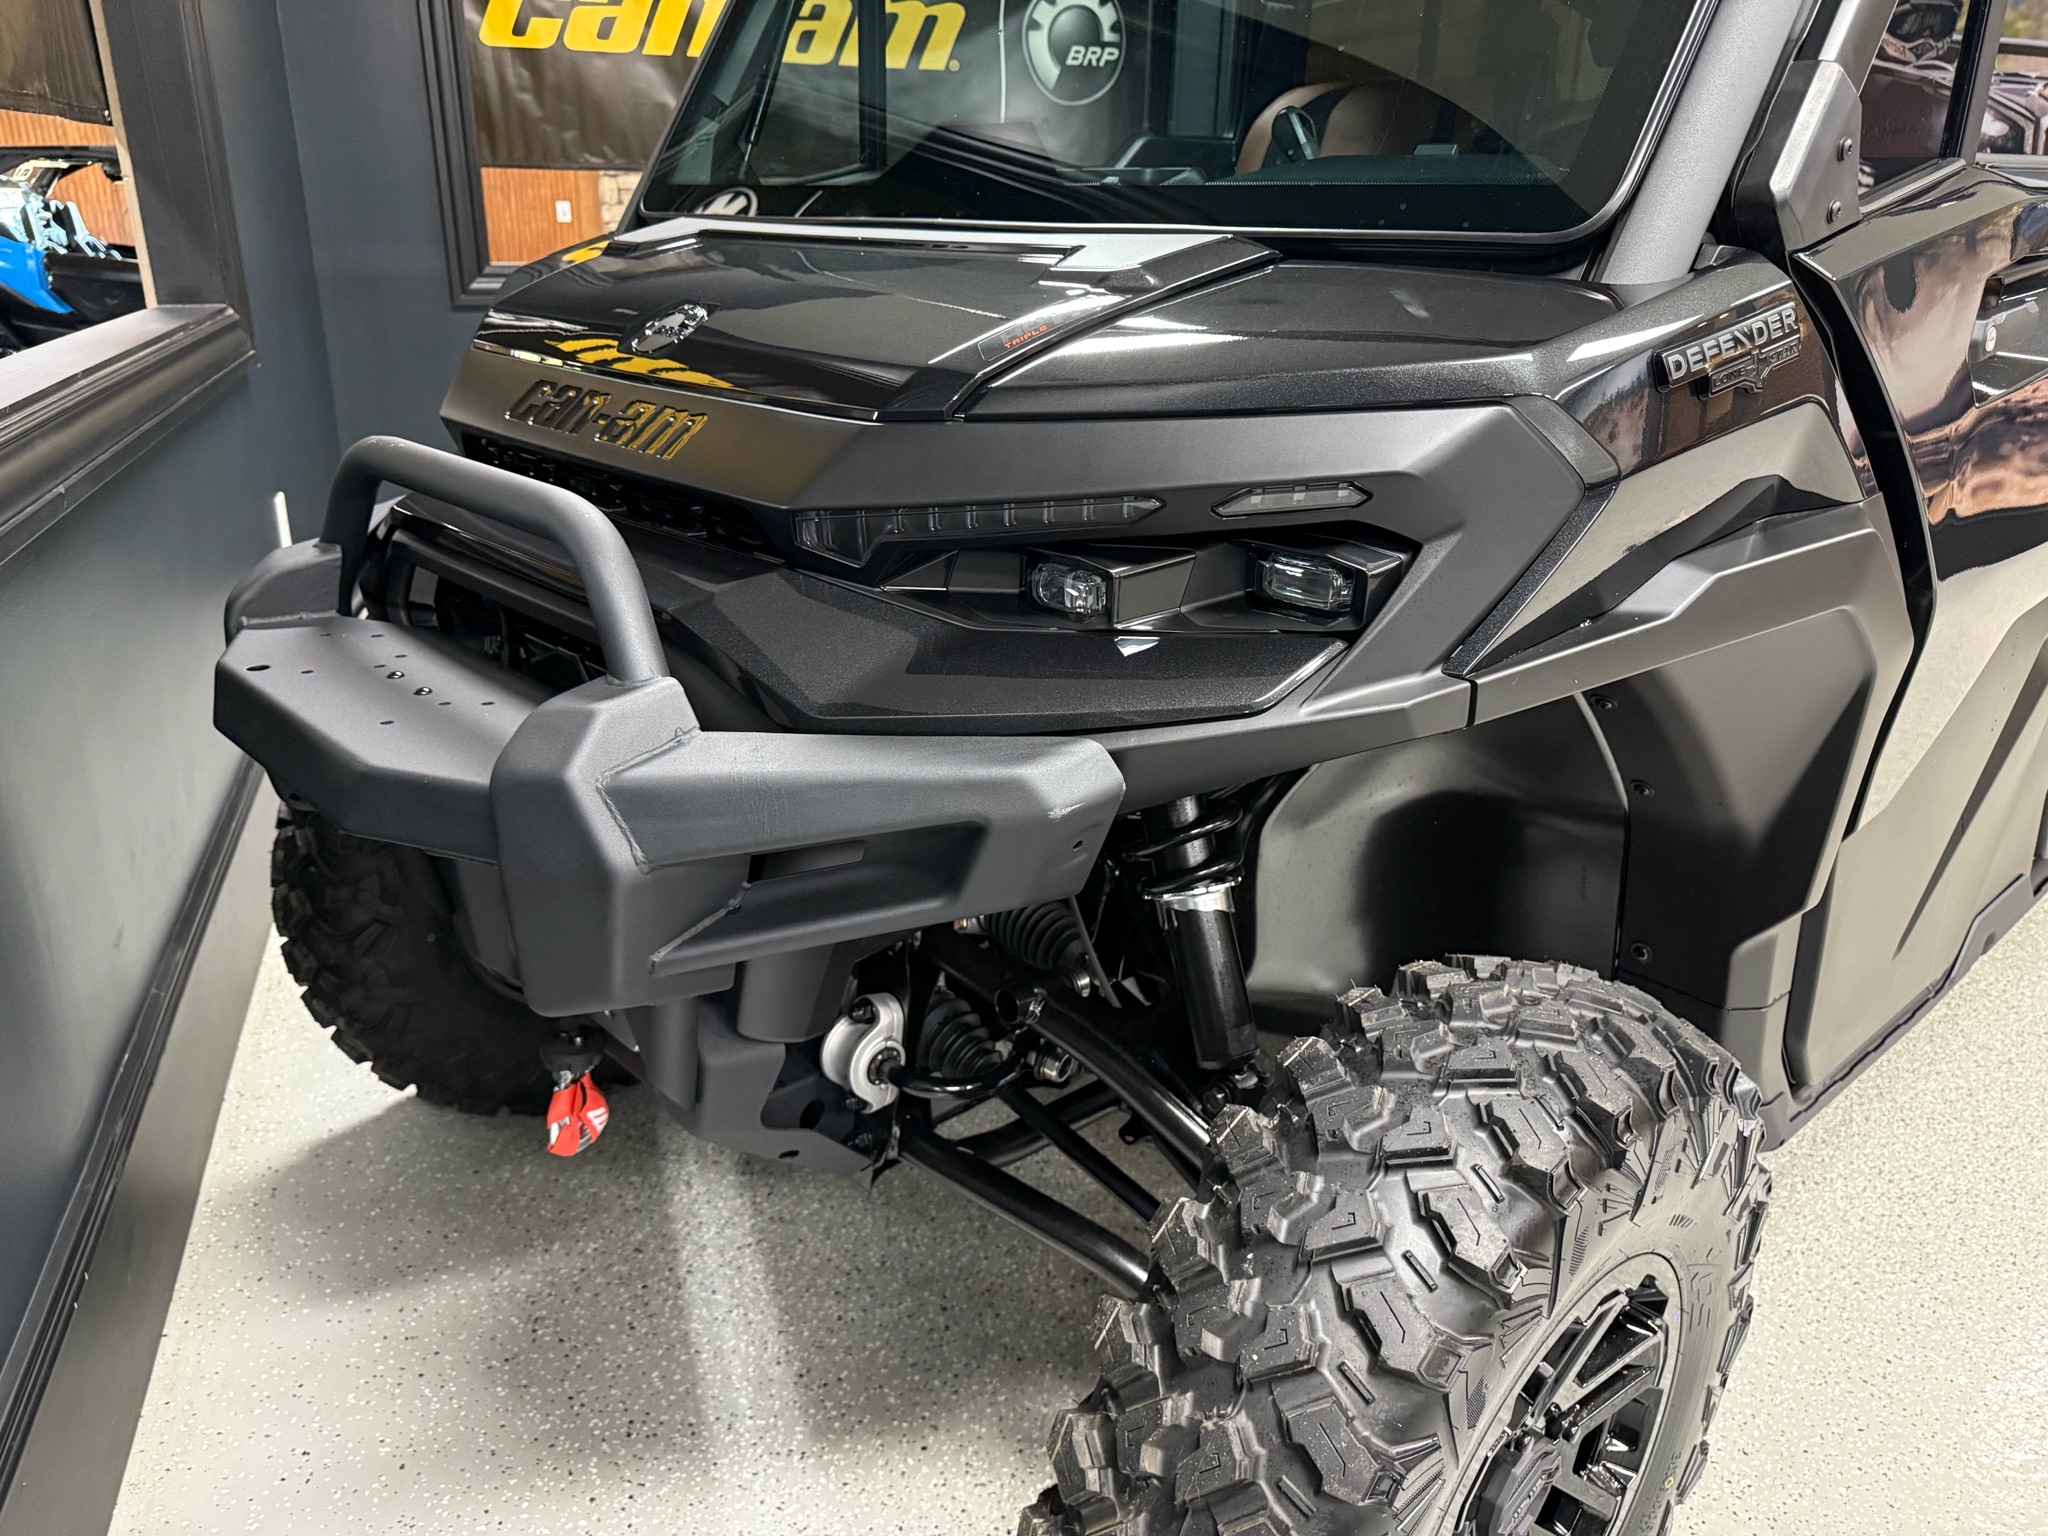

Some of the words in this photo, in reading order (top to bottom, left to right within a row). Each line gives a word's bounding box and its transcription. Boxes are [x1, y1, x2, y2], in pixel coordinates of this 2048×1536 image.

[1065, 45, 1120, 67] BRP
[1004, 324, 1048, 349] TRIPLE
[1667, 308, 1798, 380] DEFENDER
[1711, 364, 1746, 387] LONE
